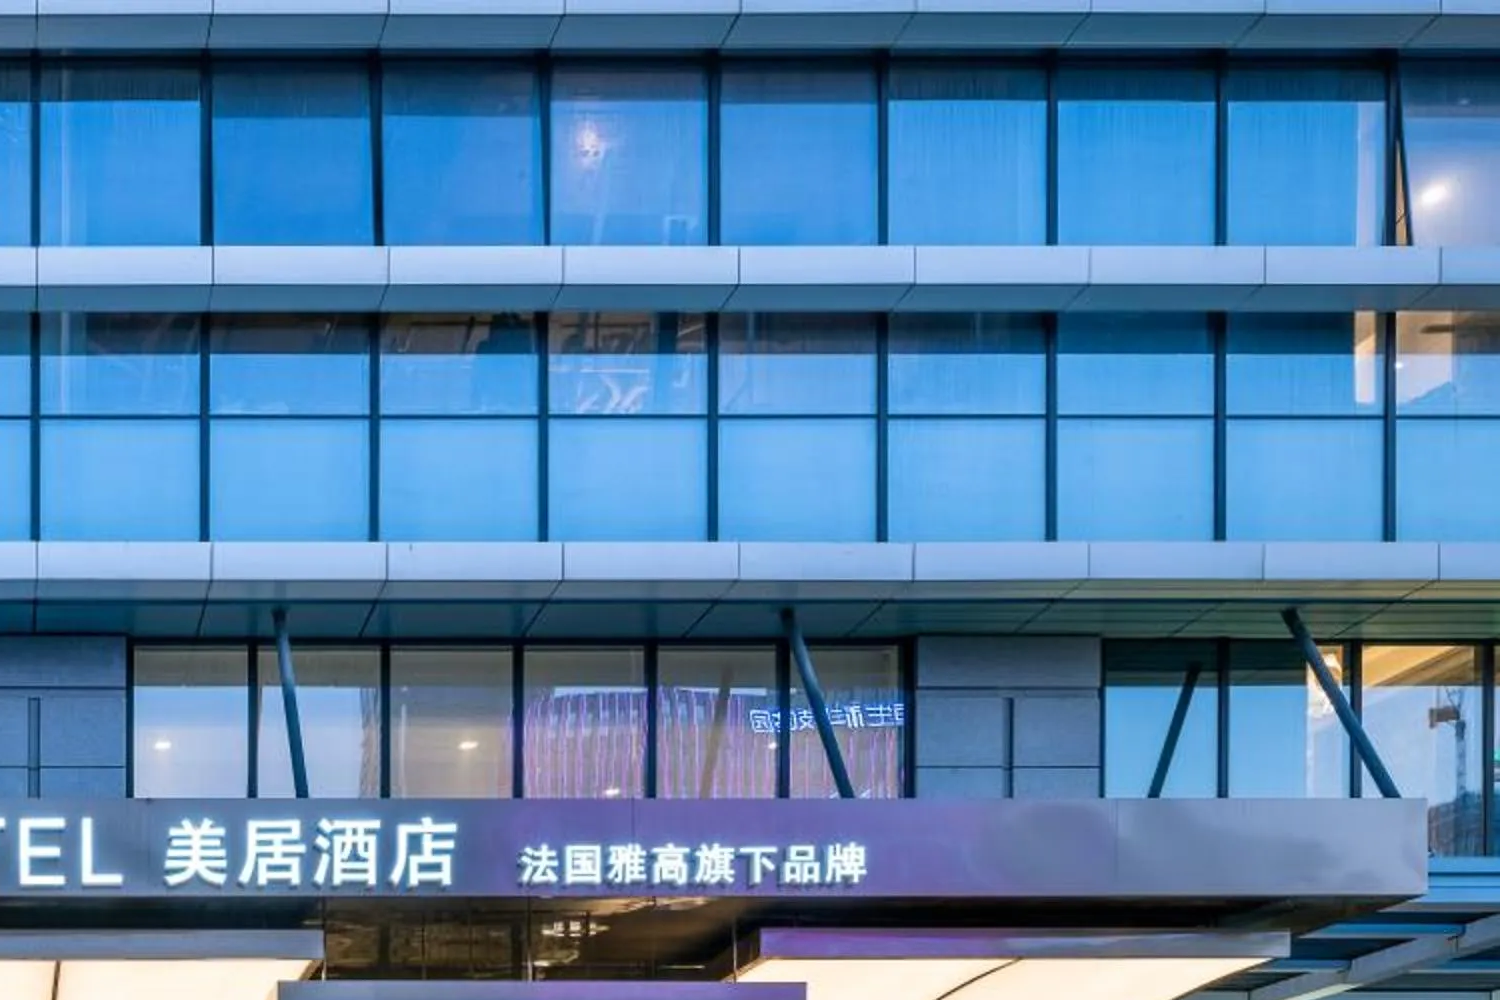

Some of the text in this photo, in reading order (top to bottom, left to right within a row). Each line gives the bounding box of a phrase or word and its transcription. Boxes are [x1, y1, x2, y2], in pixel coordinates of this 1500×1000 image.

[164, 816, 459, 887] 美居酒店
[519, 841, 869, 886] 法国雅高旗下品牌
